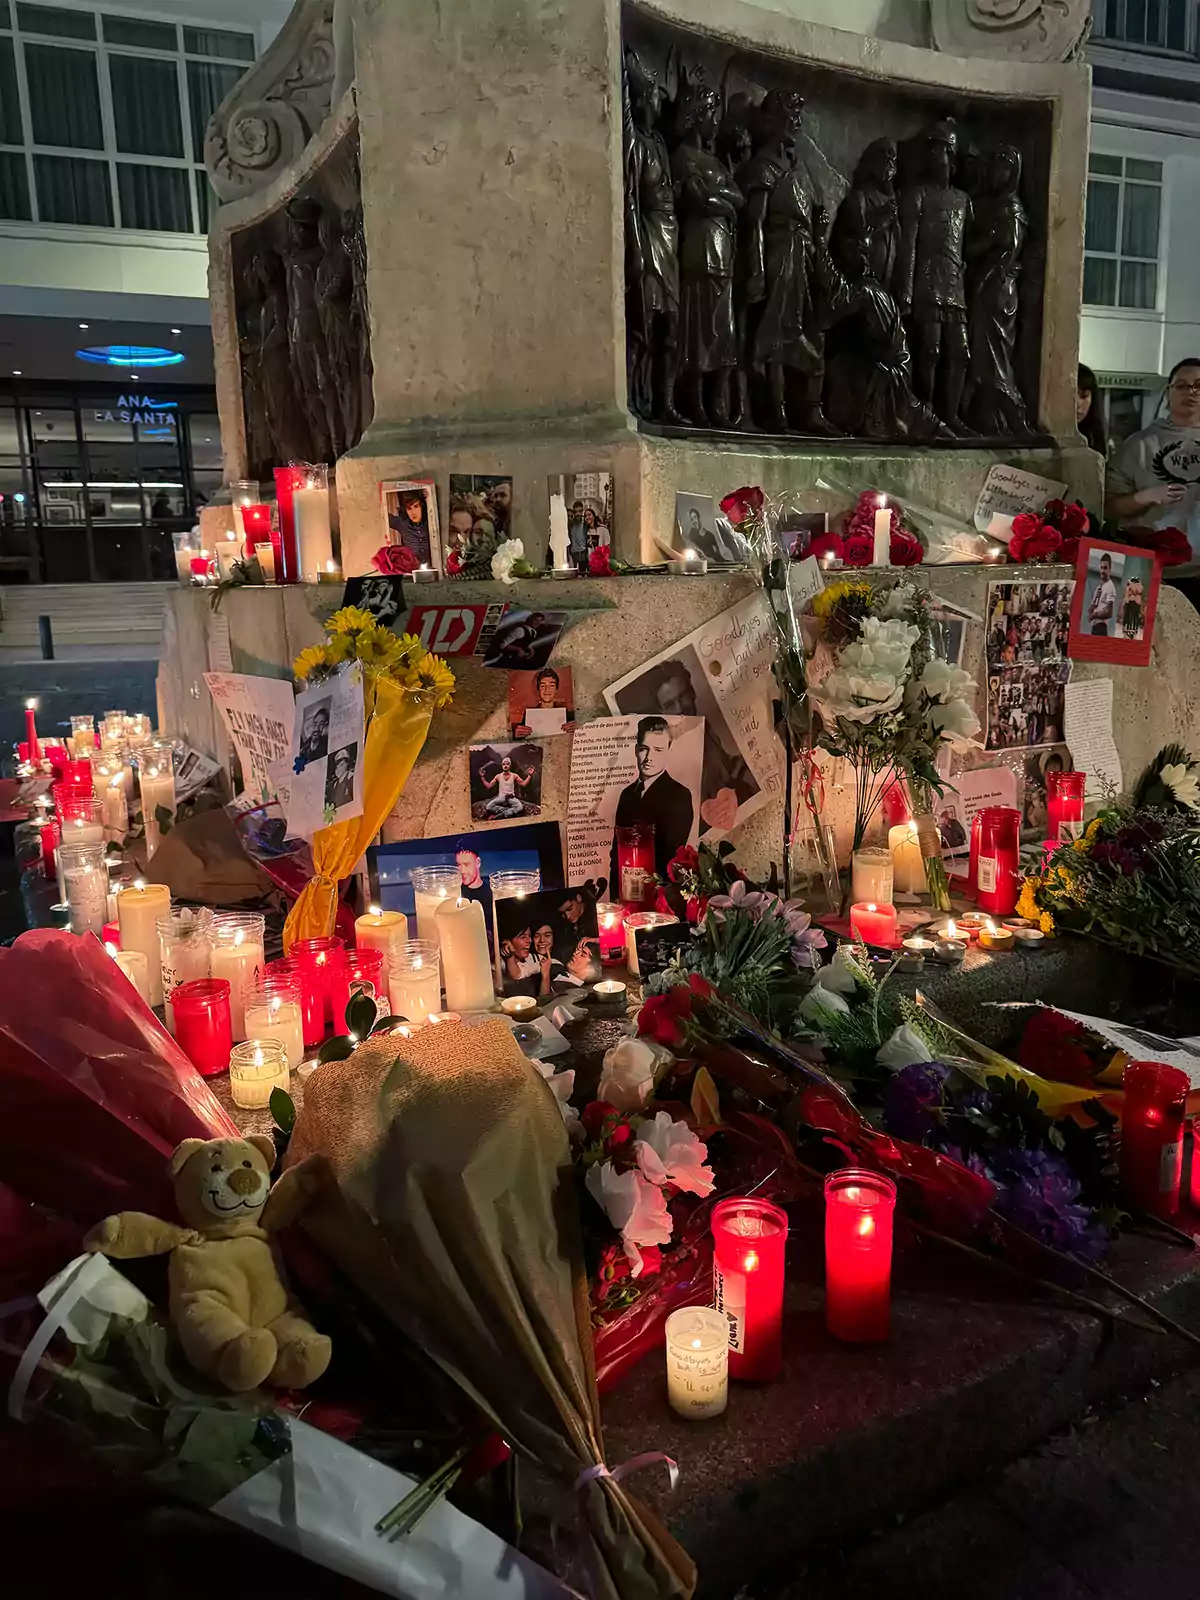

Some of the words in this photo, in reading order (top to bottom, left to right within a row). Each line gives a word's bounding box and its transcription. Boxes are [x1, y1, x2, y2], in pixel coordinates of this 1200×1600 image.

[117, 394, 151, 408] ANA
[120, 411, 176, 425] SANTA
[990, 466, 1030, 490] Goodbyes
[419, 607, 476, 653] 1D
[698, 614, 761, 658] Goodbyes
[730, 639, 753, 666] but
[753, 660, 770, 678] see
[669, 1346, 712, 1368] Goodbyes
